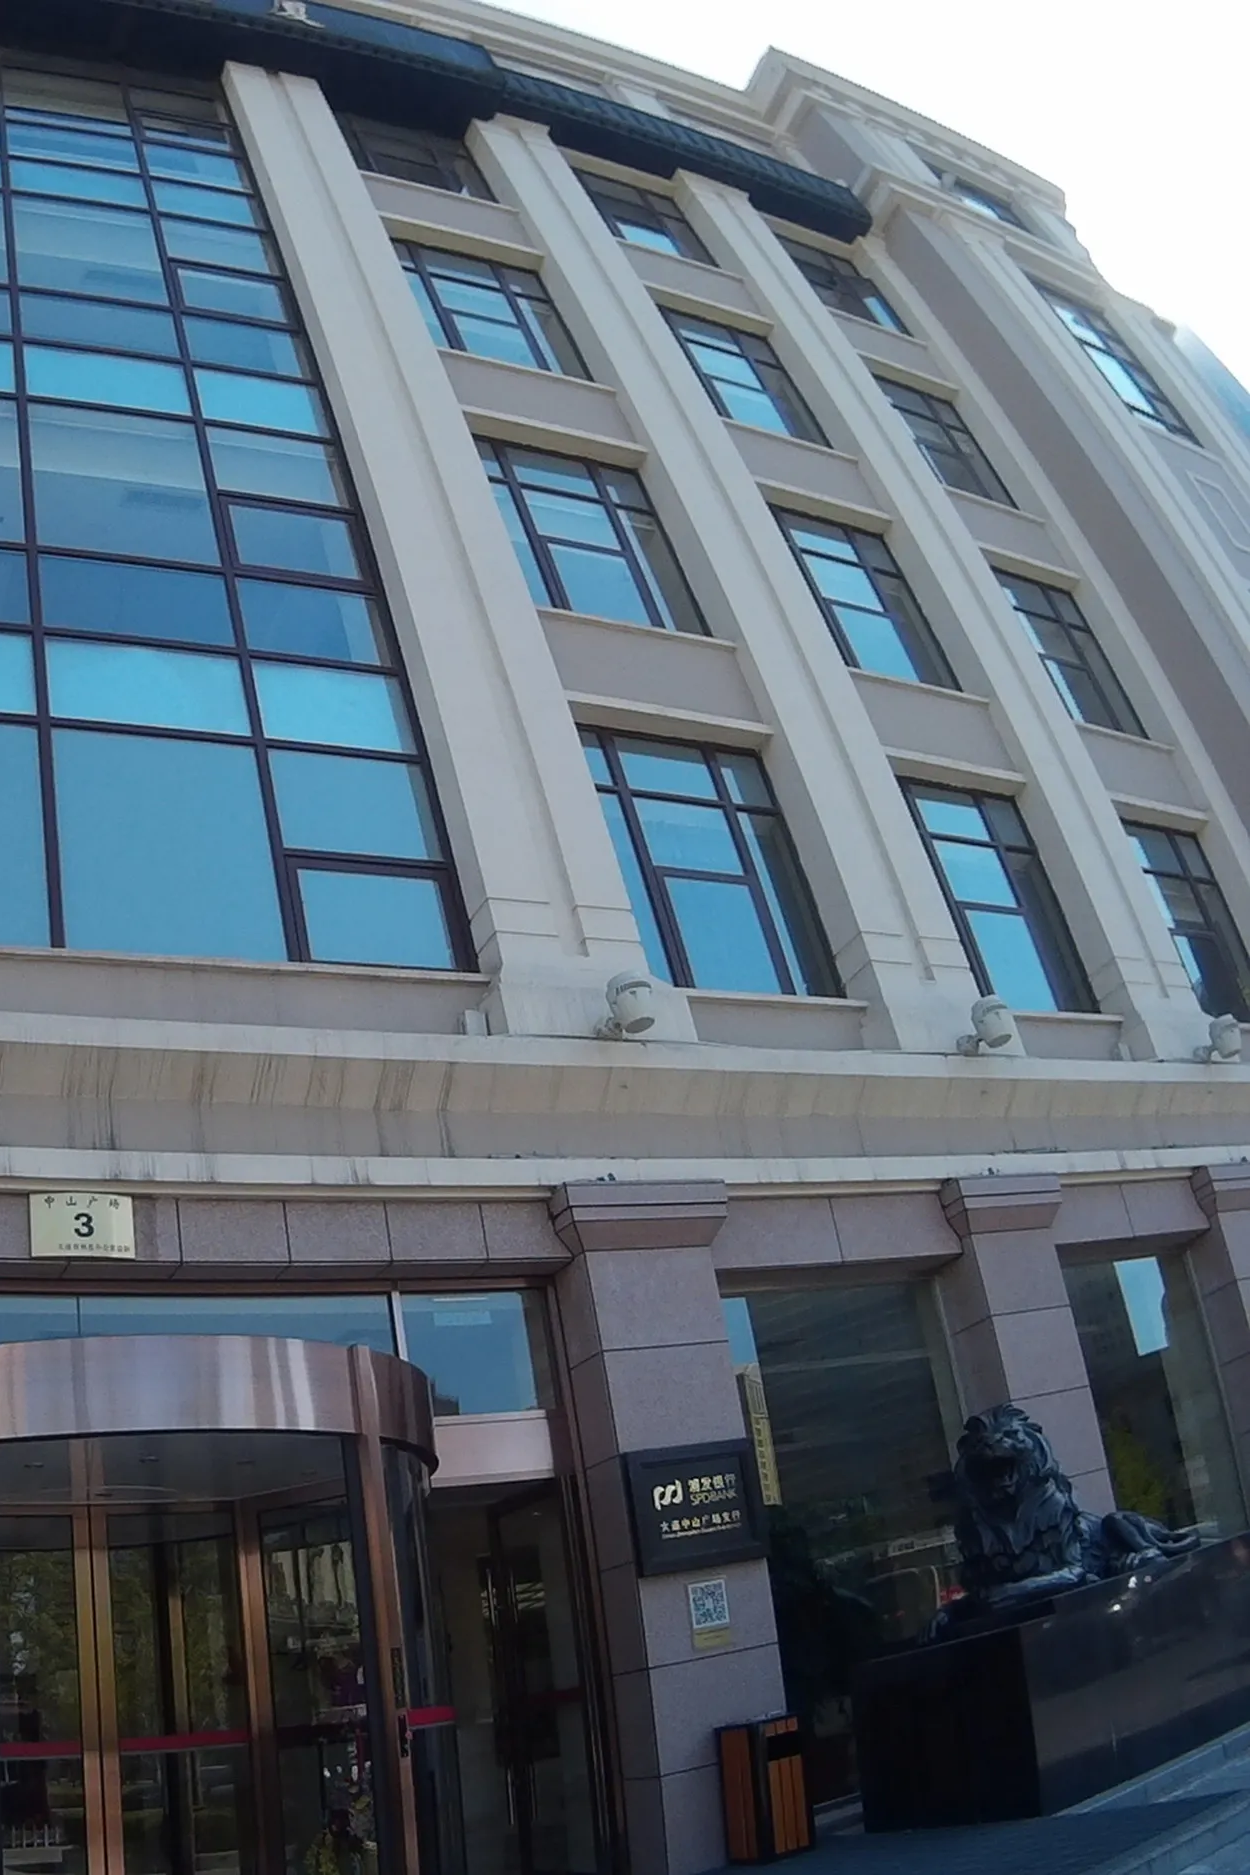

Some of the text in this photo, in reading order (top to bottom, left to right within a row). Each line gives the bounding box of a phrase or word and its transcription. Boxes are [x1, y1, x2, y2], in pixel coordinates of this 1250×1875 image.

[44, 1195, 120, 1210] 中山广场
[73, 1212, 95, 1238] 3
[687, 1472, 737, 1493] 浦发银行
